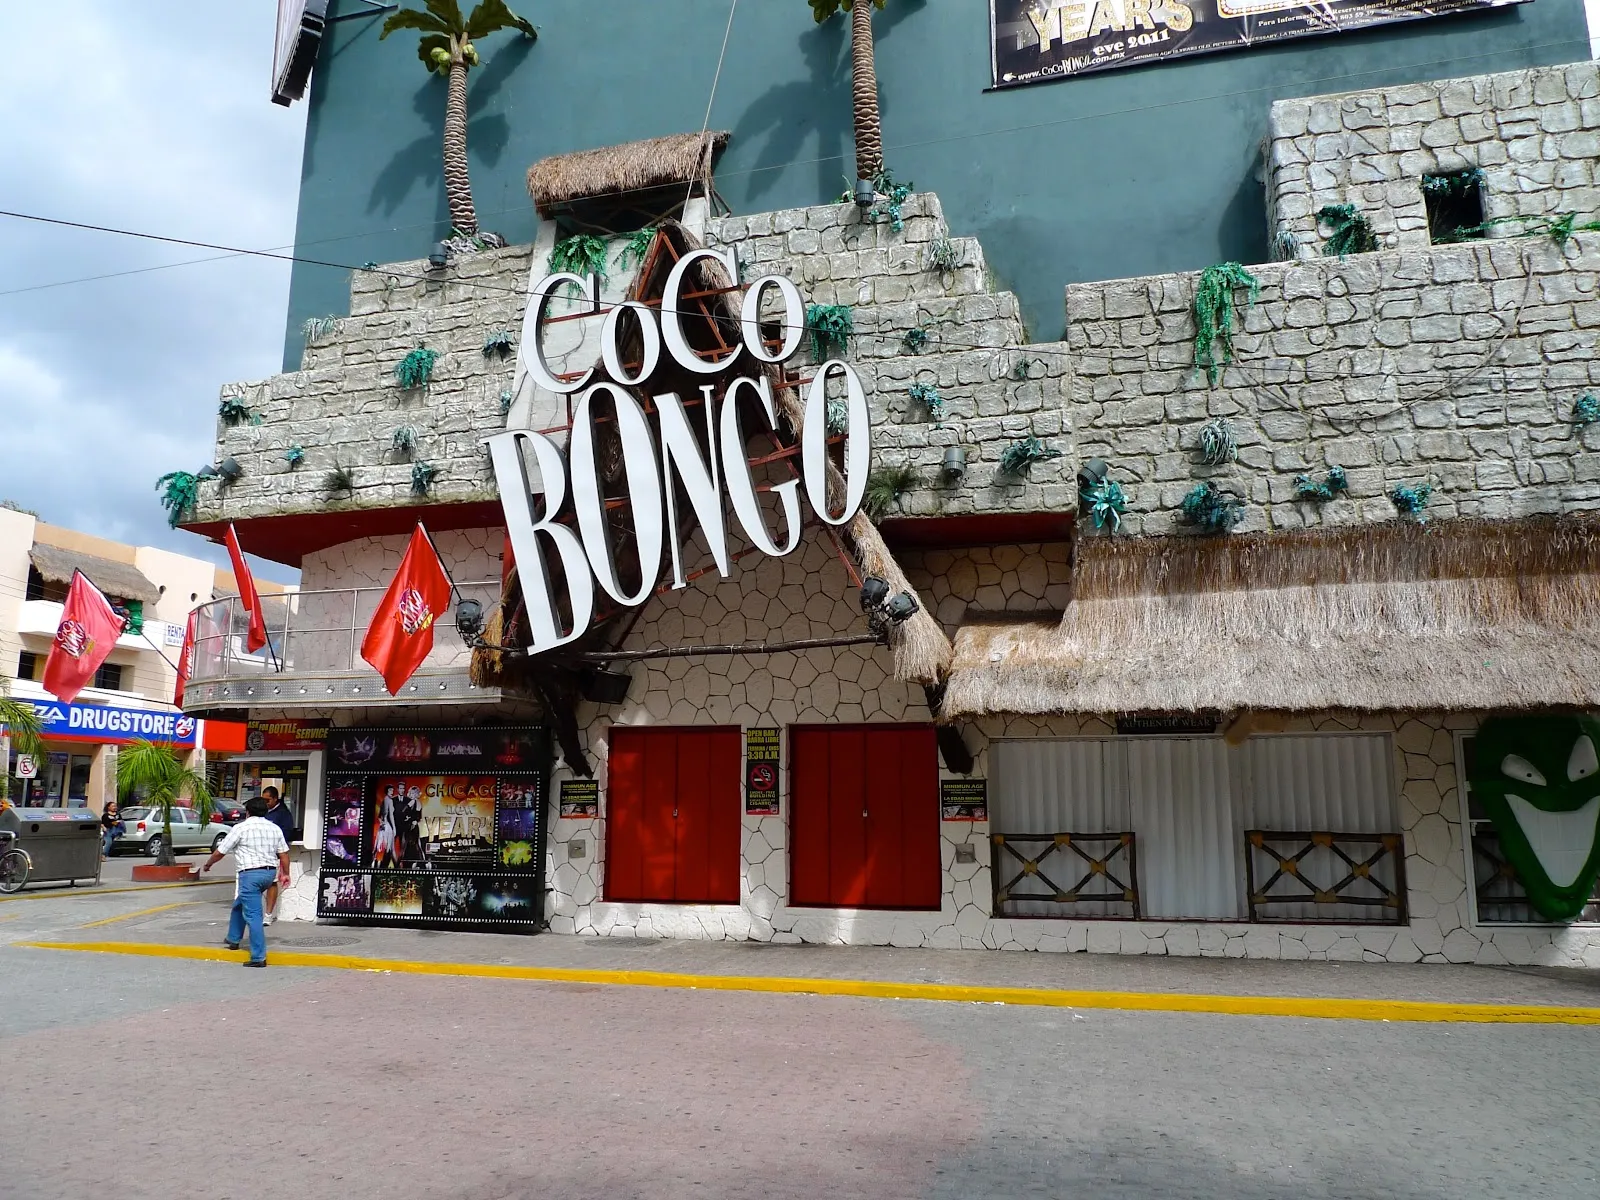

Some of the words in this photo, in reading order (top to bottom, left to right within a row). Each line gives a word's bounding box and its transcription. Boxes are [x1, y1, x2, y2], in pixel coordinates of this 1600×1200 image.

[1258, 19, 1276, 27] Para
[1093, 42, 1124, 57] eve
[1128, 29, 1171, 49] 2011
[520, 245, 806, 394] CoCo
[482, 358, 872, 656] BONGO
[68, 707, 174, 736] DRUGSTORE
[268, 723, 298, 735] BOTTLE
[296, 728, 329, 739] SERVICE
[747, 751, 764, 760] 3:30
[457, 839, 477, 847] 2011
